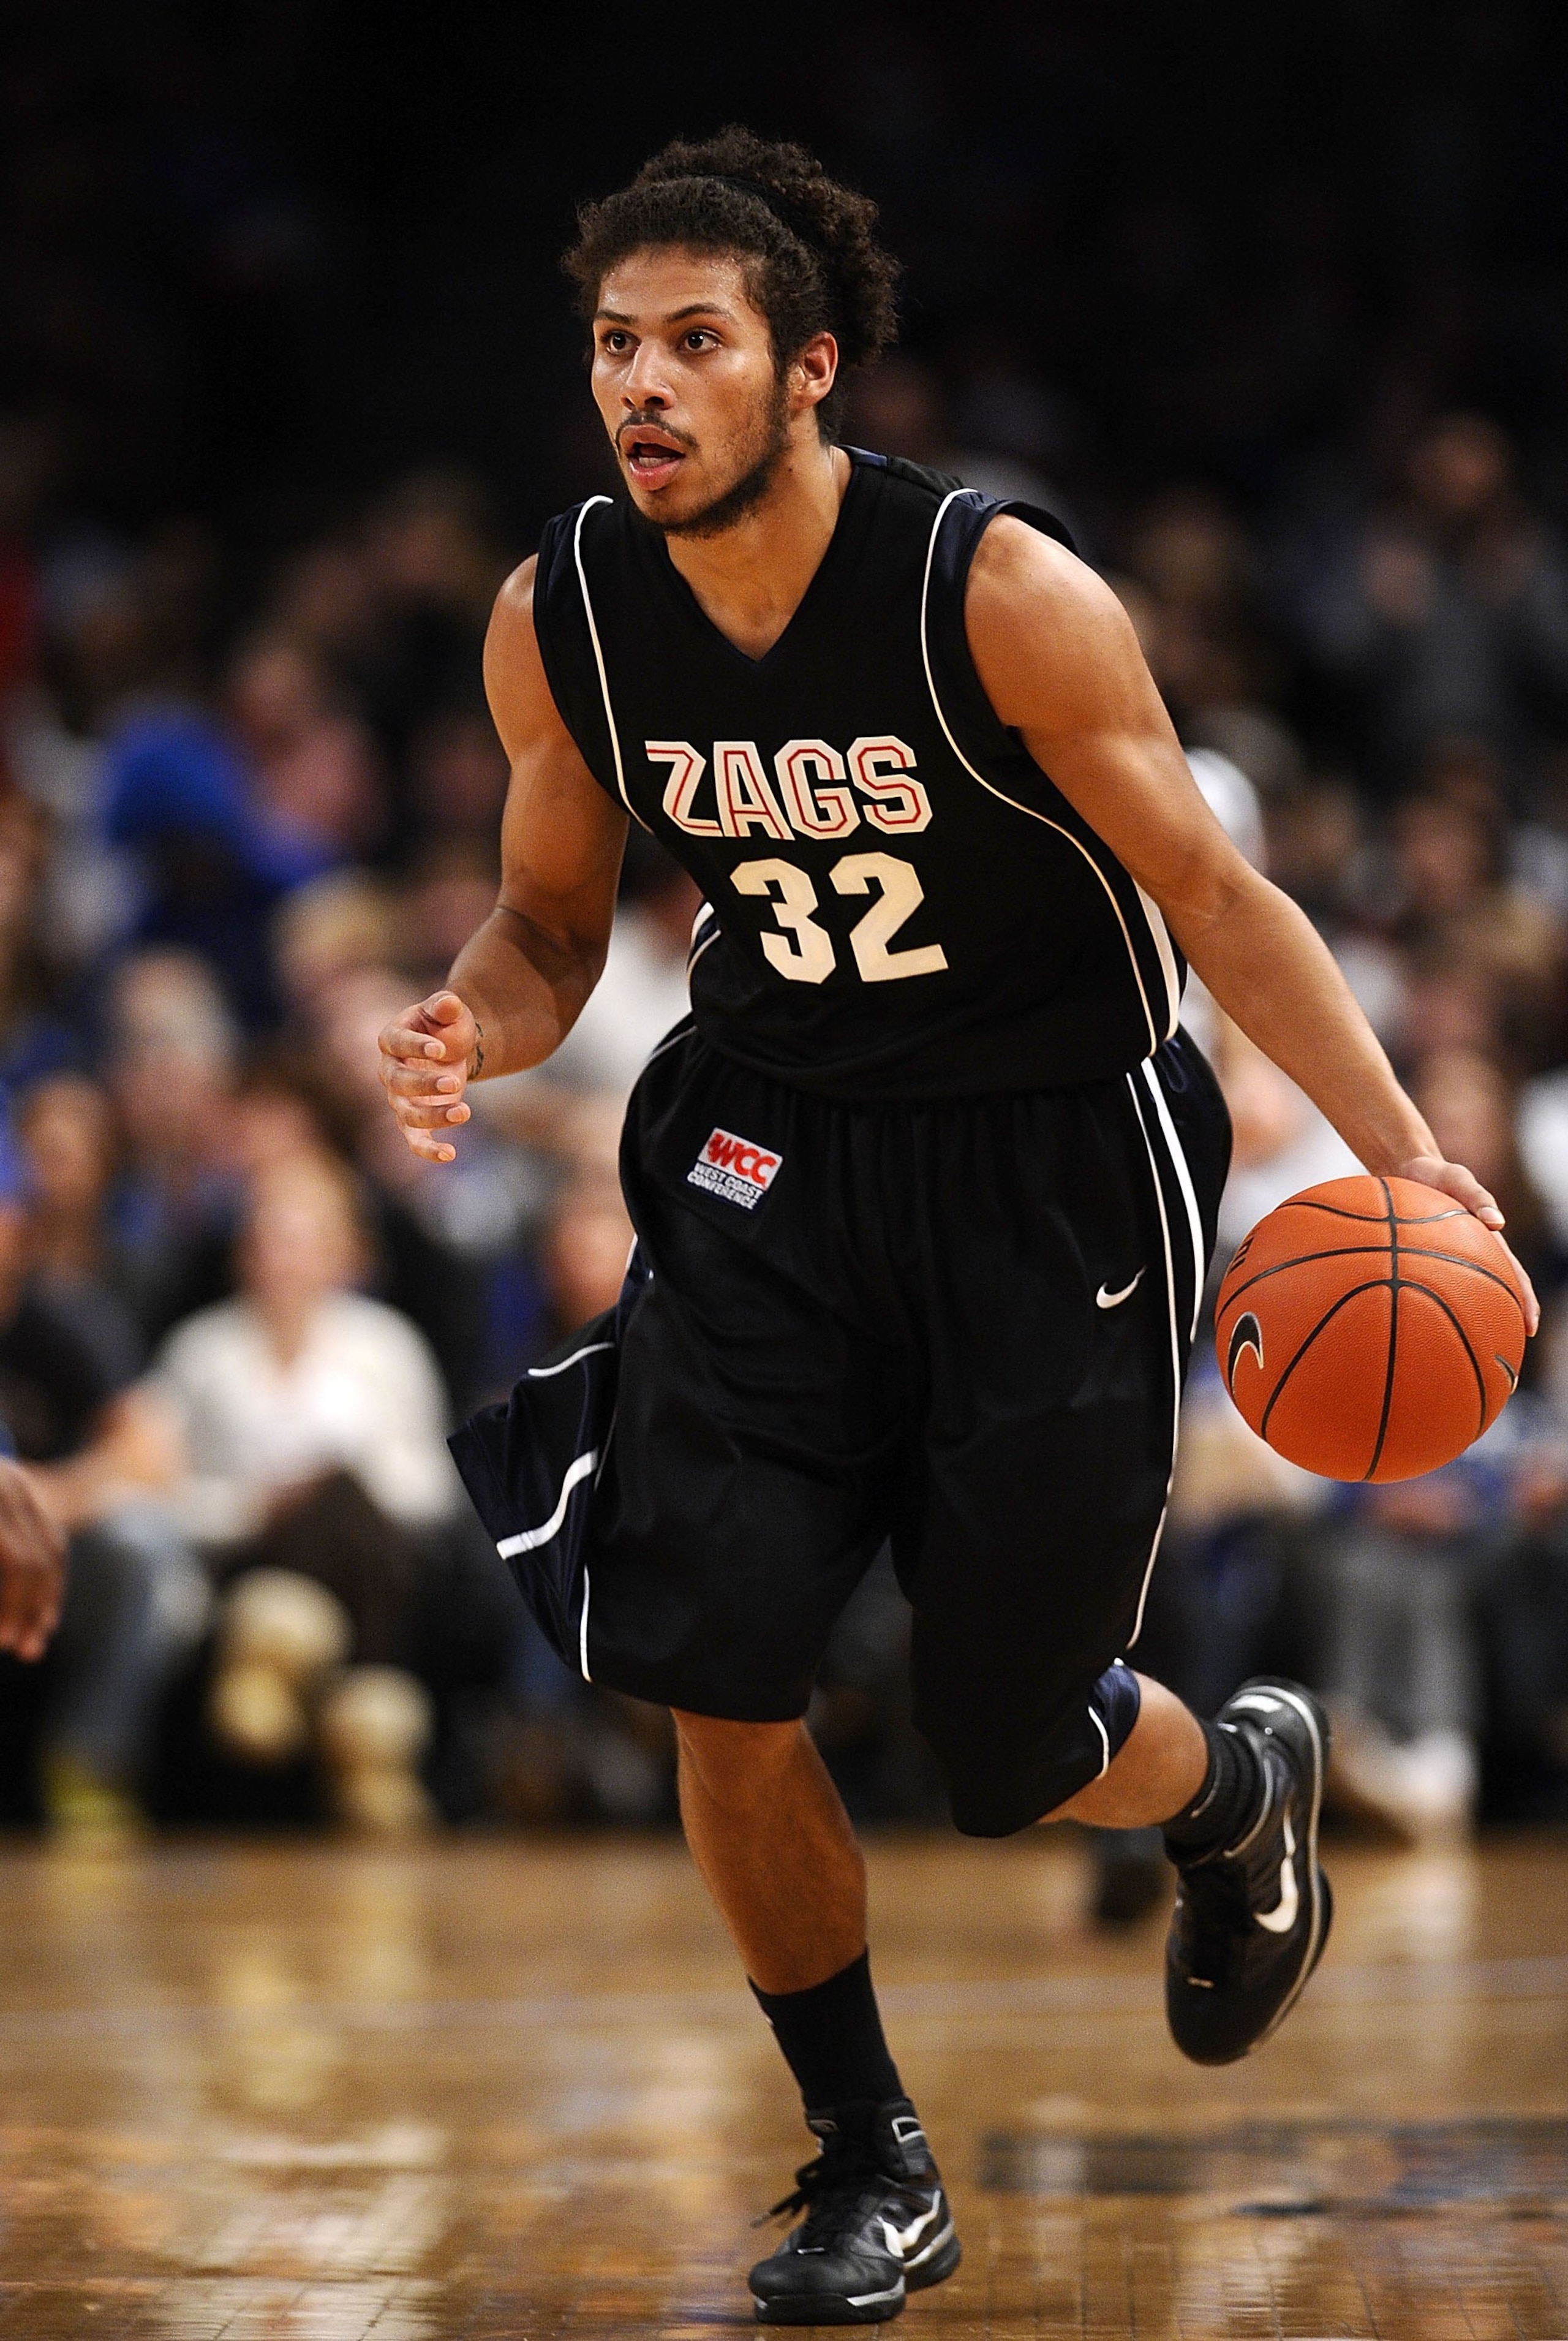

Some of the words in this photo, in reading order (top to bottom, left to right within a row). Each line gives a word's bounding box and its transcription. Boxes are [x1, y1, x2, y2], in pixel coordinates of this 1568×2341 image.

[645, 736, 933, 840] ZAGS
[730, 852, 949, 985] 32
[694, 1162, 726, 1182] WEST
[725, 1176, 764, 1199] COAST
[708, 1132, 777, 1186] WCC
[687, 1171, 757, 1210] CONFERENCE
